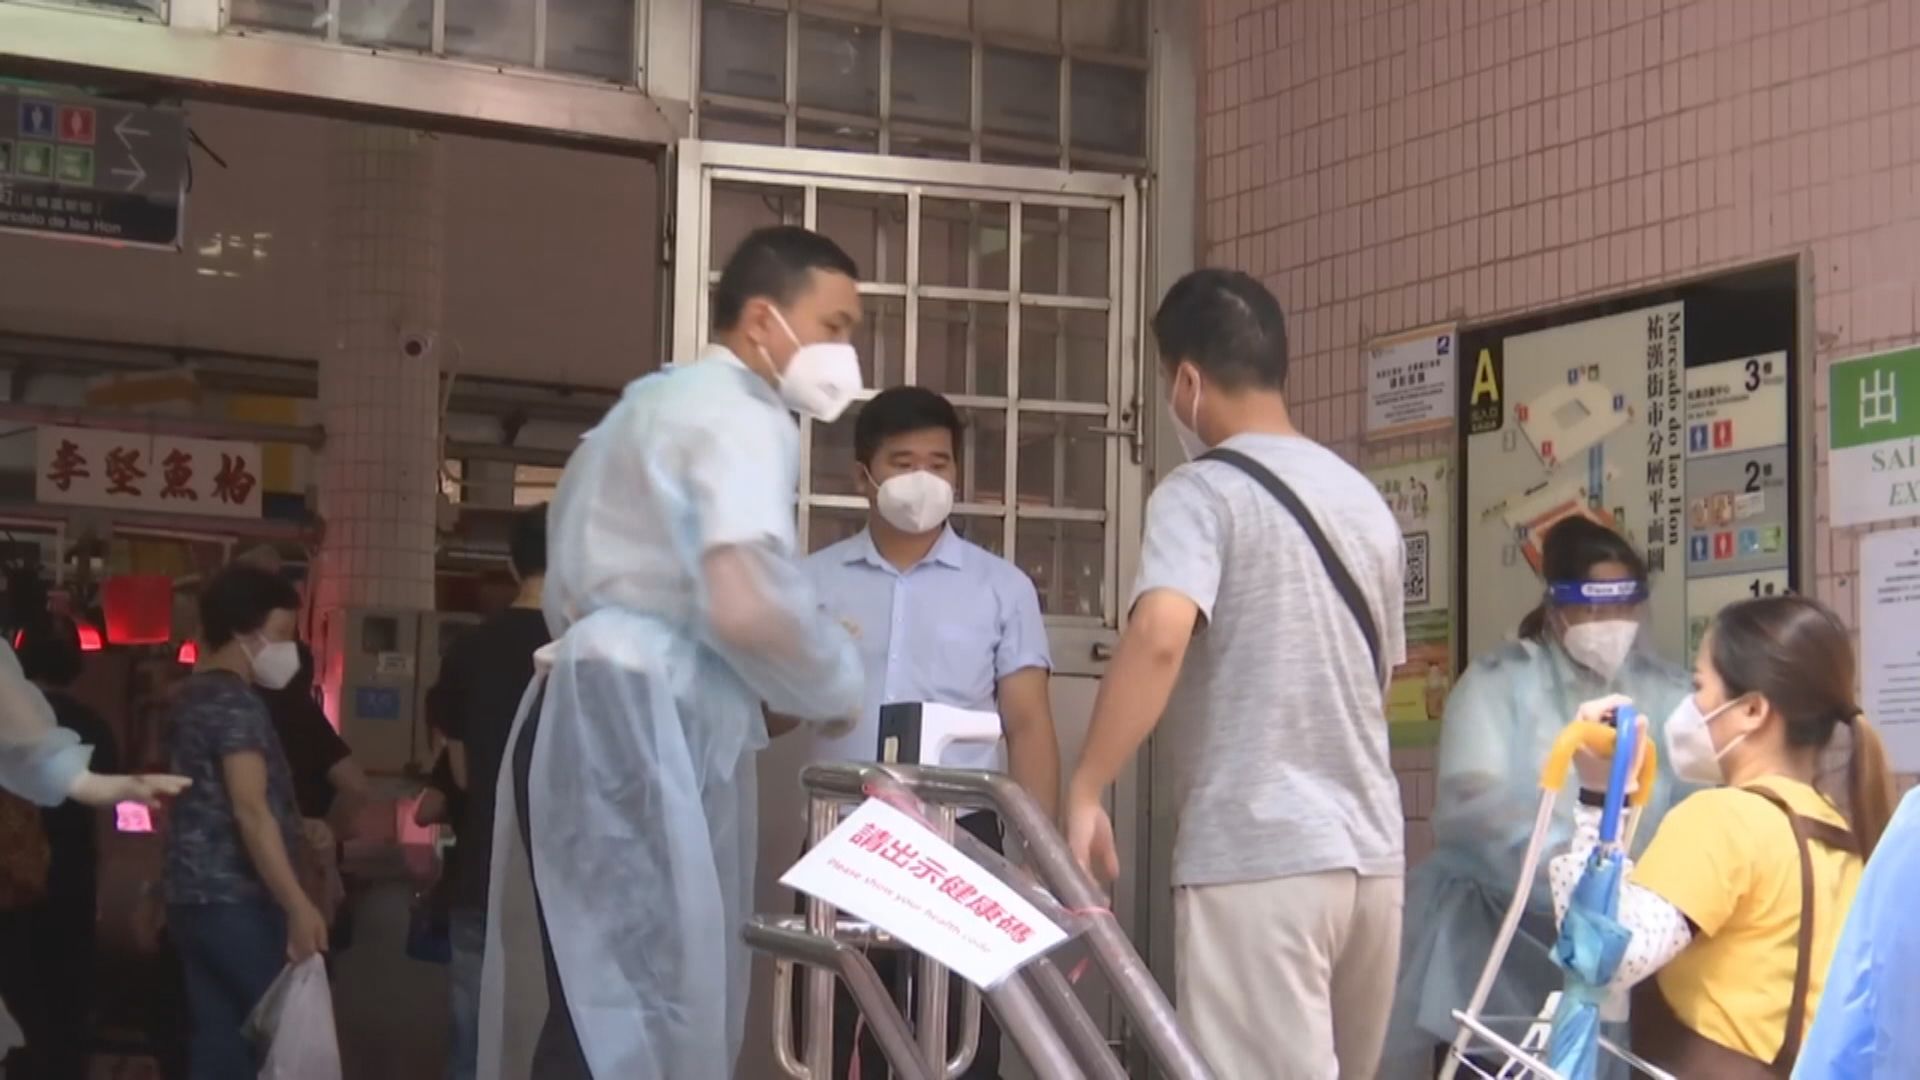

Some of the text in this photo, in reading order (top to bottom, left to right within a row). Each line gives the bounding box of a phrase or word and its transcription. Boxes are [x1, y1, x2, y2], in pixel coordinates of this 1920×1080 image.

[0, 209, 45, 225] ercado
[1470, 347, 1499, 405] A
[1668, 312, 1681, 410] Mercado
[1745, 360, 1760, 391] 3
[1860, 370, 1896, 429] 出
[1668, 417, 1681, 446] do
[1745, 461, 1760, 493] 2
[1668, 497, 1681, 545] Hon
[1749, 579, 1759, 598] 1
[827, 857, 862, 880] Please
[864, 876, 894, 896] show
[894, 893, 922, 911] your
[924, 908, 961, 936] health
[849, 822, 1035, 944] 請出示健康碼
